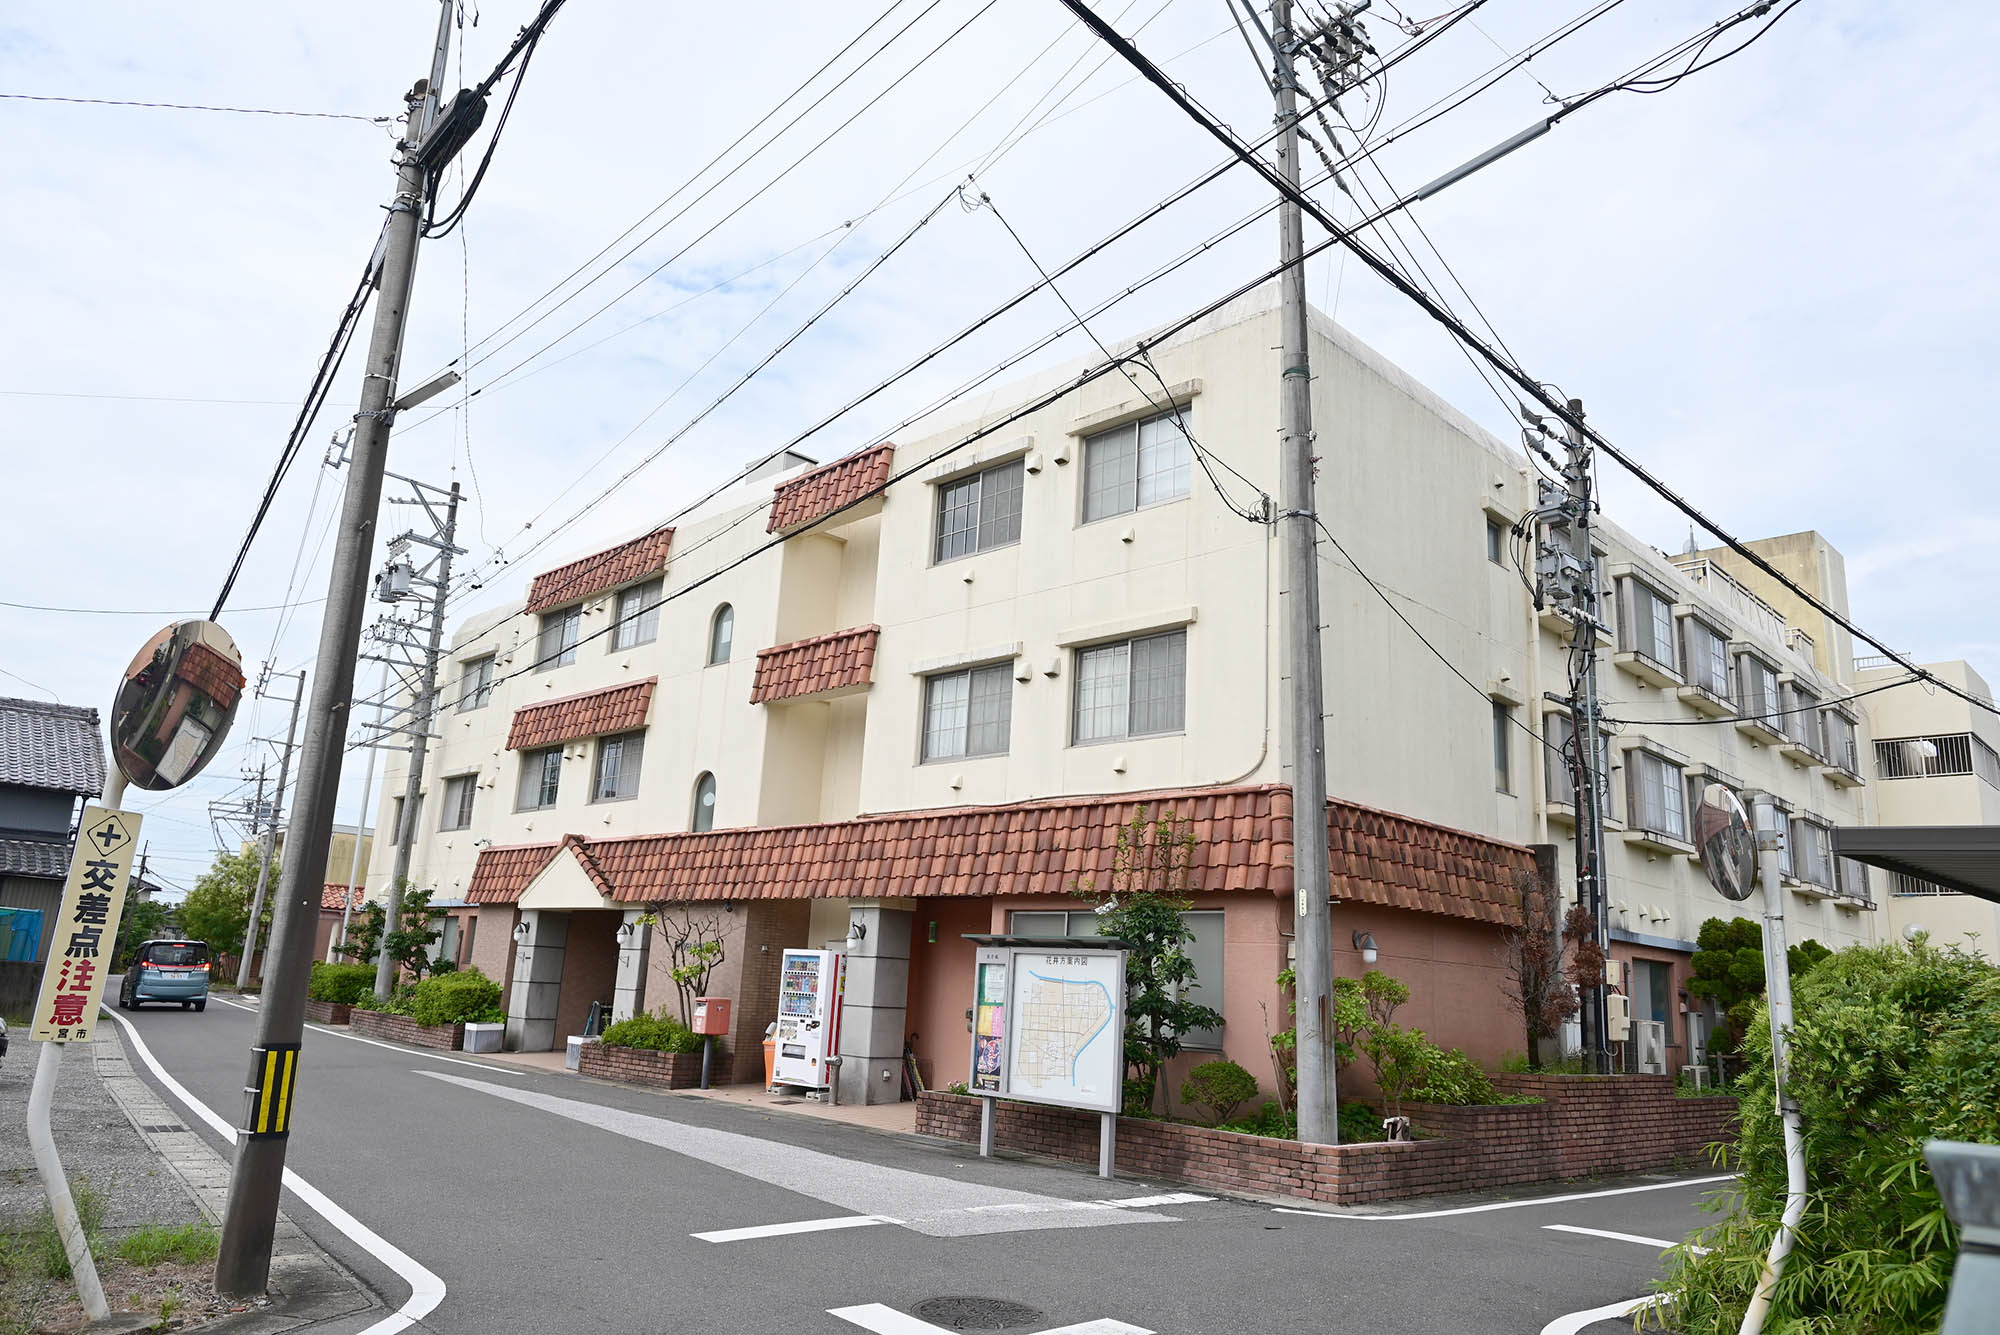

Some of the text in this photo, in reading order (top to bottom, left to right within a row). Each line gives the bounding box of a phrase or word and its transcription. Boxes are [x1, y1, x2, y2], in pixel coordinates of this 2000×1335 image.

[49, 859, 119, 1026] 交差点注意
[40, 1028, 87, 1039] 一宮市
